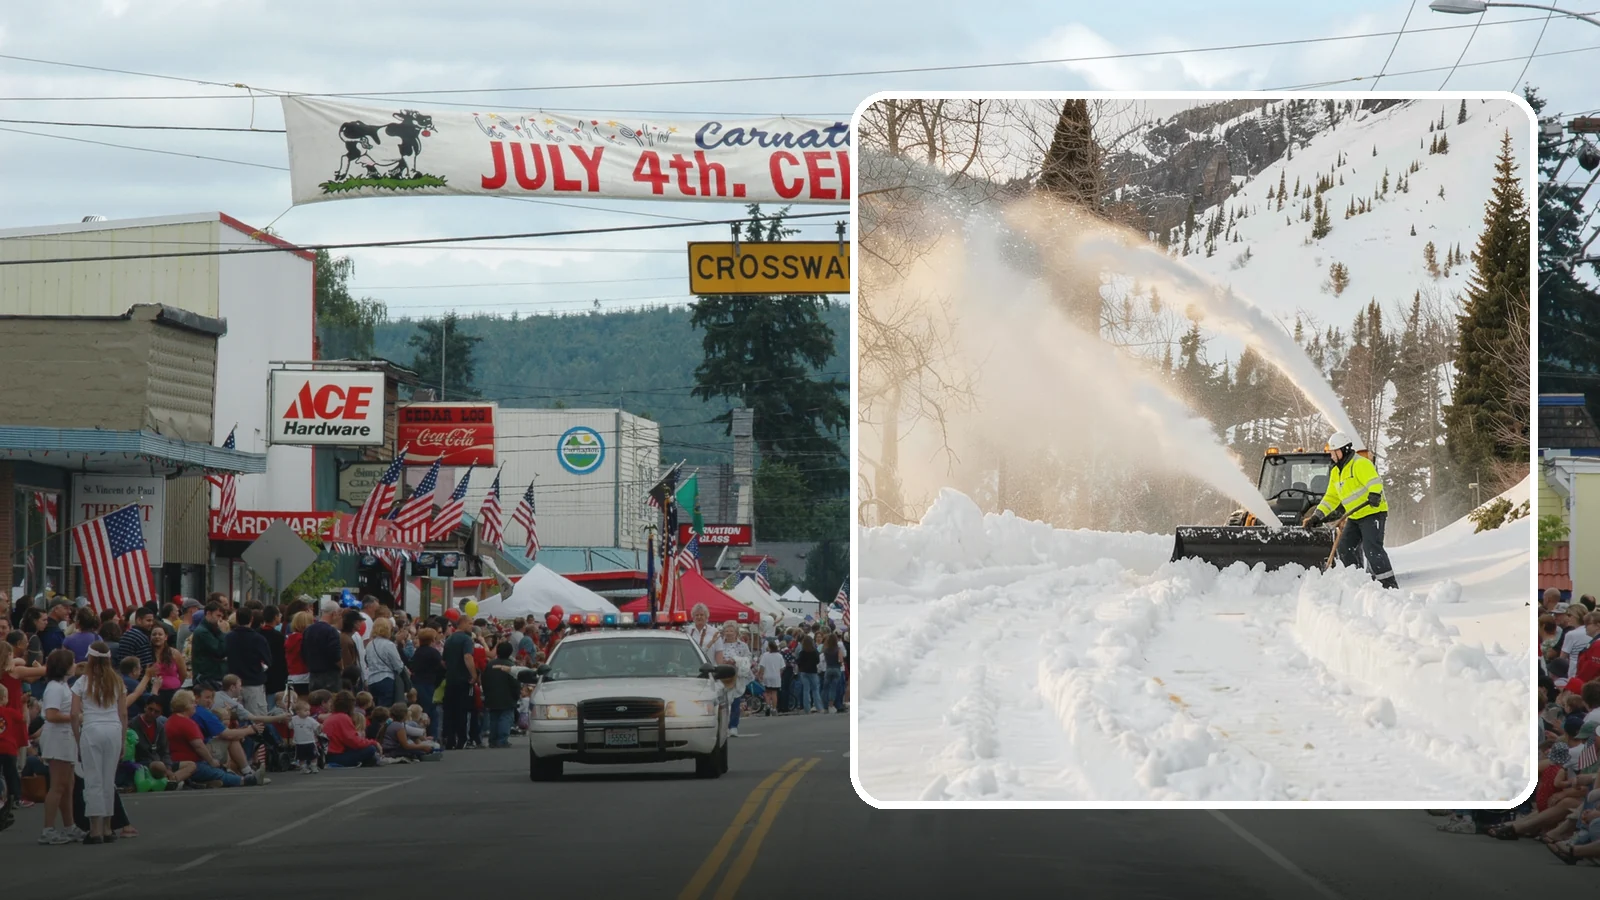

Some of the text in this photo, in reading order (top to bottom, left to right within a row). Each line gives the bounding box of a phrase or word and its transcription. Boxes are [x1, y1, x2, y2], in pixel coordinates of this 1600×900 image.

[695, 121, 850, 150] Carnat
[481, 141, 604, 192] JULY
[632, 147, 746, 197] 4th.
[697, 254, 850, 279] CROSSWA
[282, 380, 373, 419] ACE
[406, 409, 485, 422] CEDAR LOG
[283, 421, 371, 436] Hardware
[354, 467, 386, 480] Simpl
[96, 485, 124, 494] Vincent
[126, 486, 136, 494] de
[138, 486, 155, 495] Paul
[688, 526, 741, 534] CRNATION
[699, 535, 730, 543] GLASS
